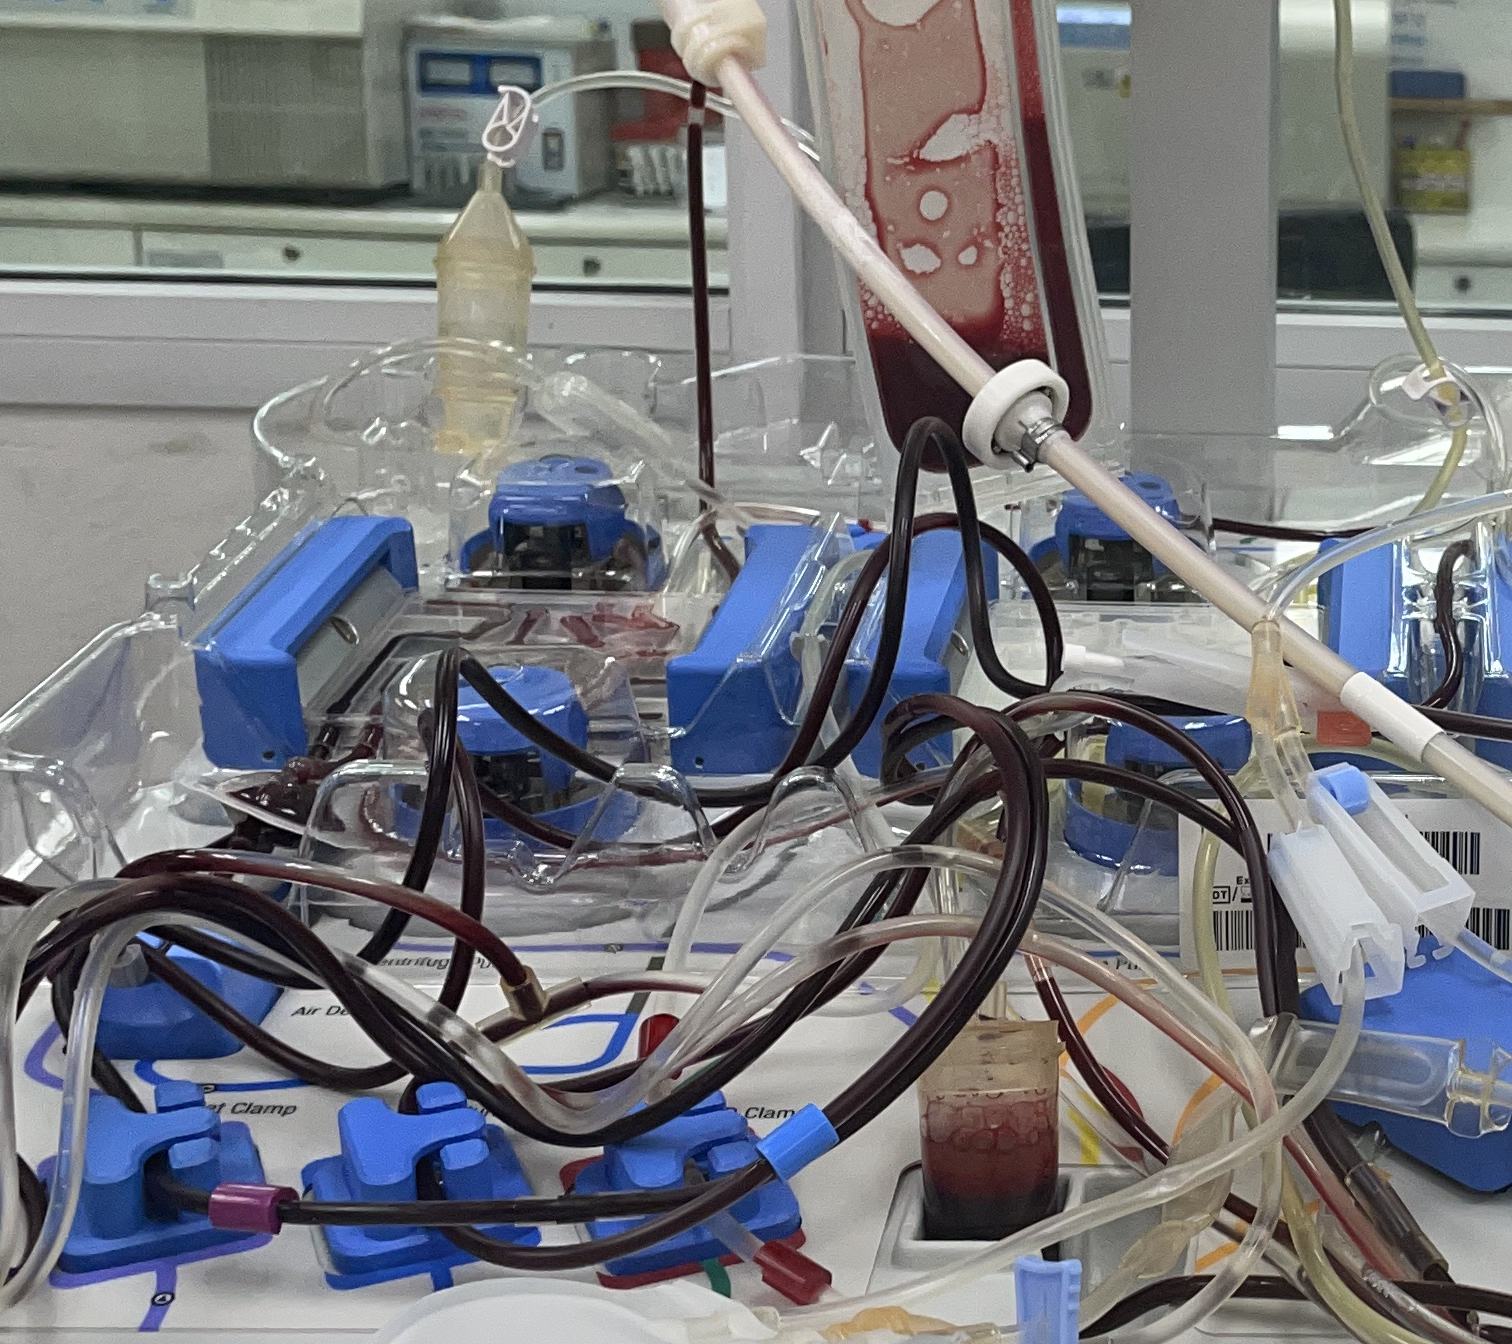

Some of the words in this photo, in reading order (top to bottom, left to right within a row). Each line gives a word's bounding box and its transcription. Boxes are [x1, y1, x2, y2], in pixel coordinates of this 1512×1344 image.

[1212, 890, 1228, 900] OT
[290, 1005, 322, 1017] Air
[231, 1102, 297, 1117] Clamp
[745, 1106, 796, 1119] Clam
